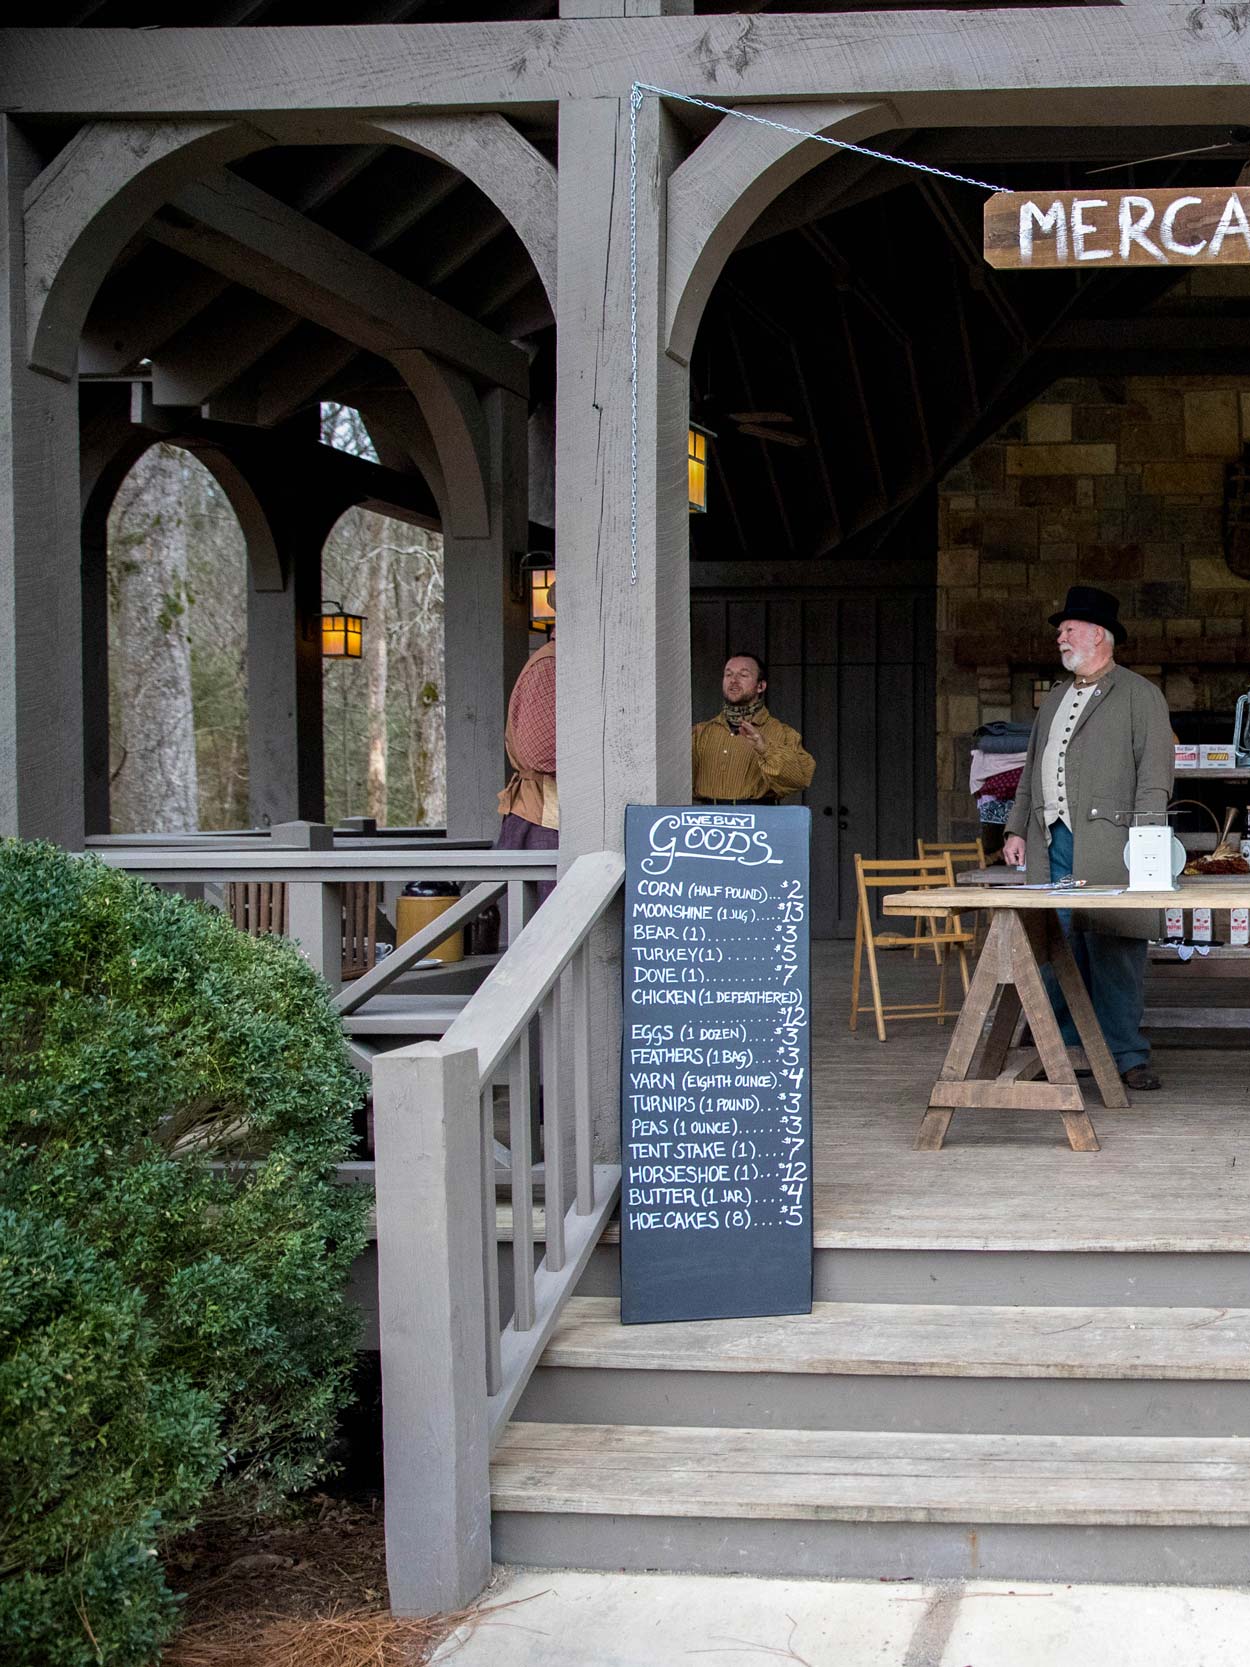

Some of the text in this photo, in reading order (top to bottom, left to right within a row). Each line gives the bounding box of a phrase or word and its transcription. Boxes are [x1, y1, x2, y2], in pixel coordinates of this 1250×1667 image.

[686, 816, 750, 826] WE BUY
[641, 815, 773, 874] GOODS
[638, 880, 683, 896] CORN
[633, 903, 713, 920] MOONSHINE
[634, 925, 679, 940] BEAR
[632, 947, 699, 961] TURKEY
[634, 967, 678, 983] DOVE
[632, 989, 695, 1005] CHICKEN
[631, 1025, 673, 1045] EGGS
[631, 1048, 703, 1065] FEATHERS
[630, 1072, 674, 1089] YARN
[629, 1095, 696, 1113] TURNIPS
[632, 1119, 669, 1138] PEAS
[629, 1143, 672, 1159] TENT
[673, 1142, 726, 1159] STAKE
[629, 1166, 730, 1184] HORSESHOE
[629, 1188, 699, 1207] BUTTER
